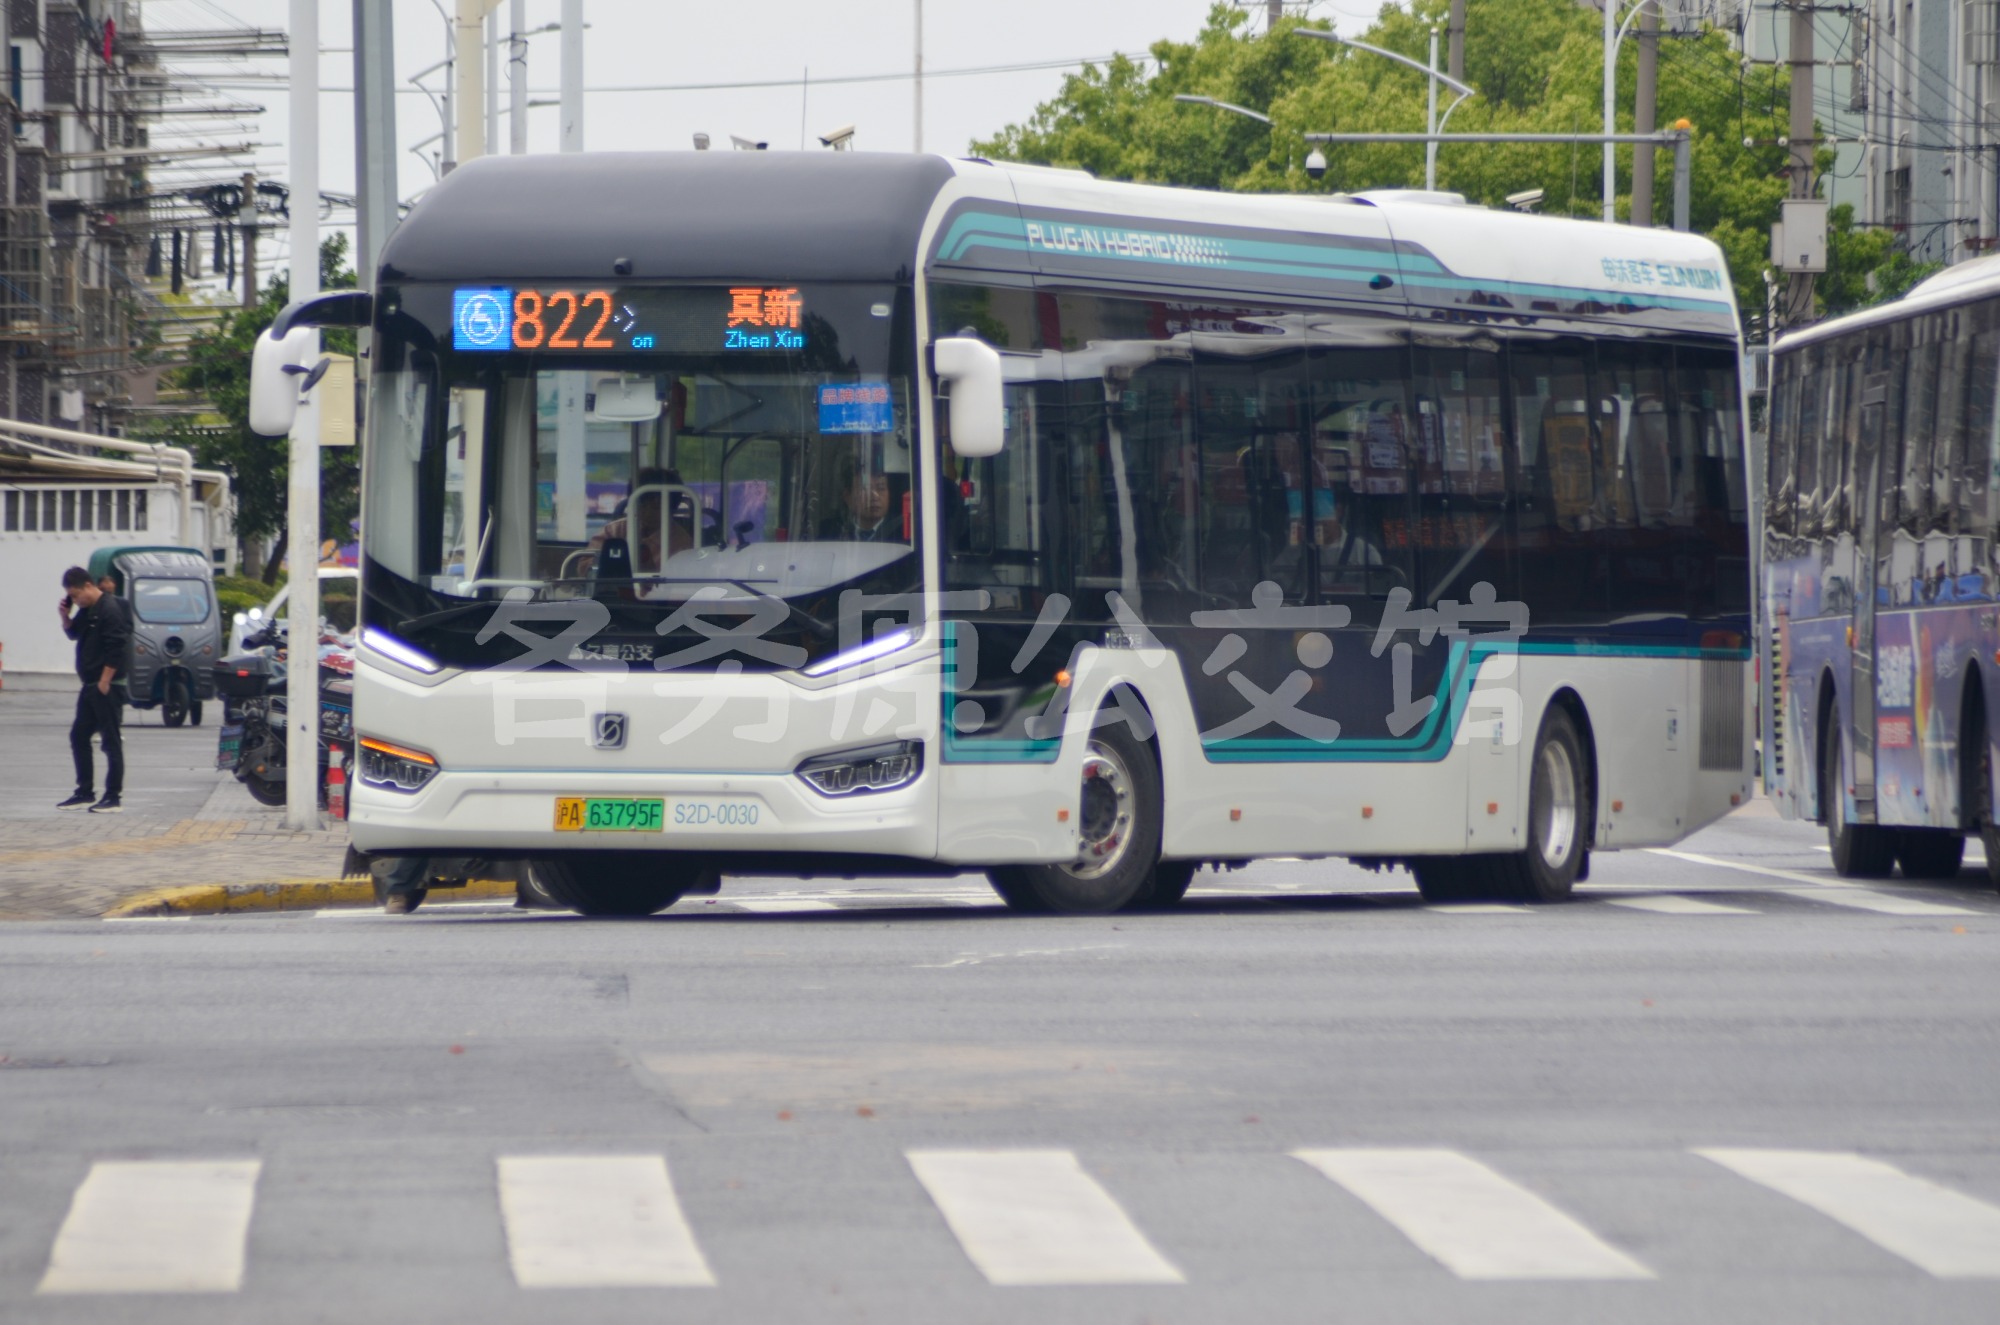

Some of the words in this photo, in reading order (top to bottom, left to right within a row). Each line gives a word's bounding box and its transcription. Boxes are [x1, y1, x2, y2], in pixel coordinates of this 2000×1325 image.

[1026, 223, 1102, 253] PLUG-IN
[1104, 231, 1172, 259] HYBRID
[511, 288, 614, 348] 822
[727, 288, 803, 328] 真新
[632, 334, 653, 348] on
[725, 330, 769, 348] Zhen
[775, 330, 803, 348] Xin
[821, 387, 888, 405] 品牌线路
[589, 803, 661, 826] 63795F
[674, 803, 759, 825] S2D-0030
